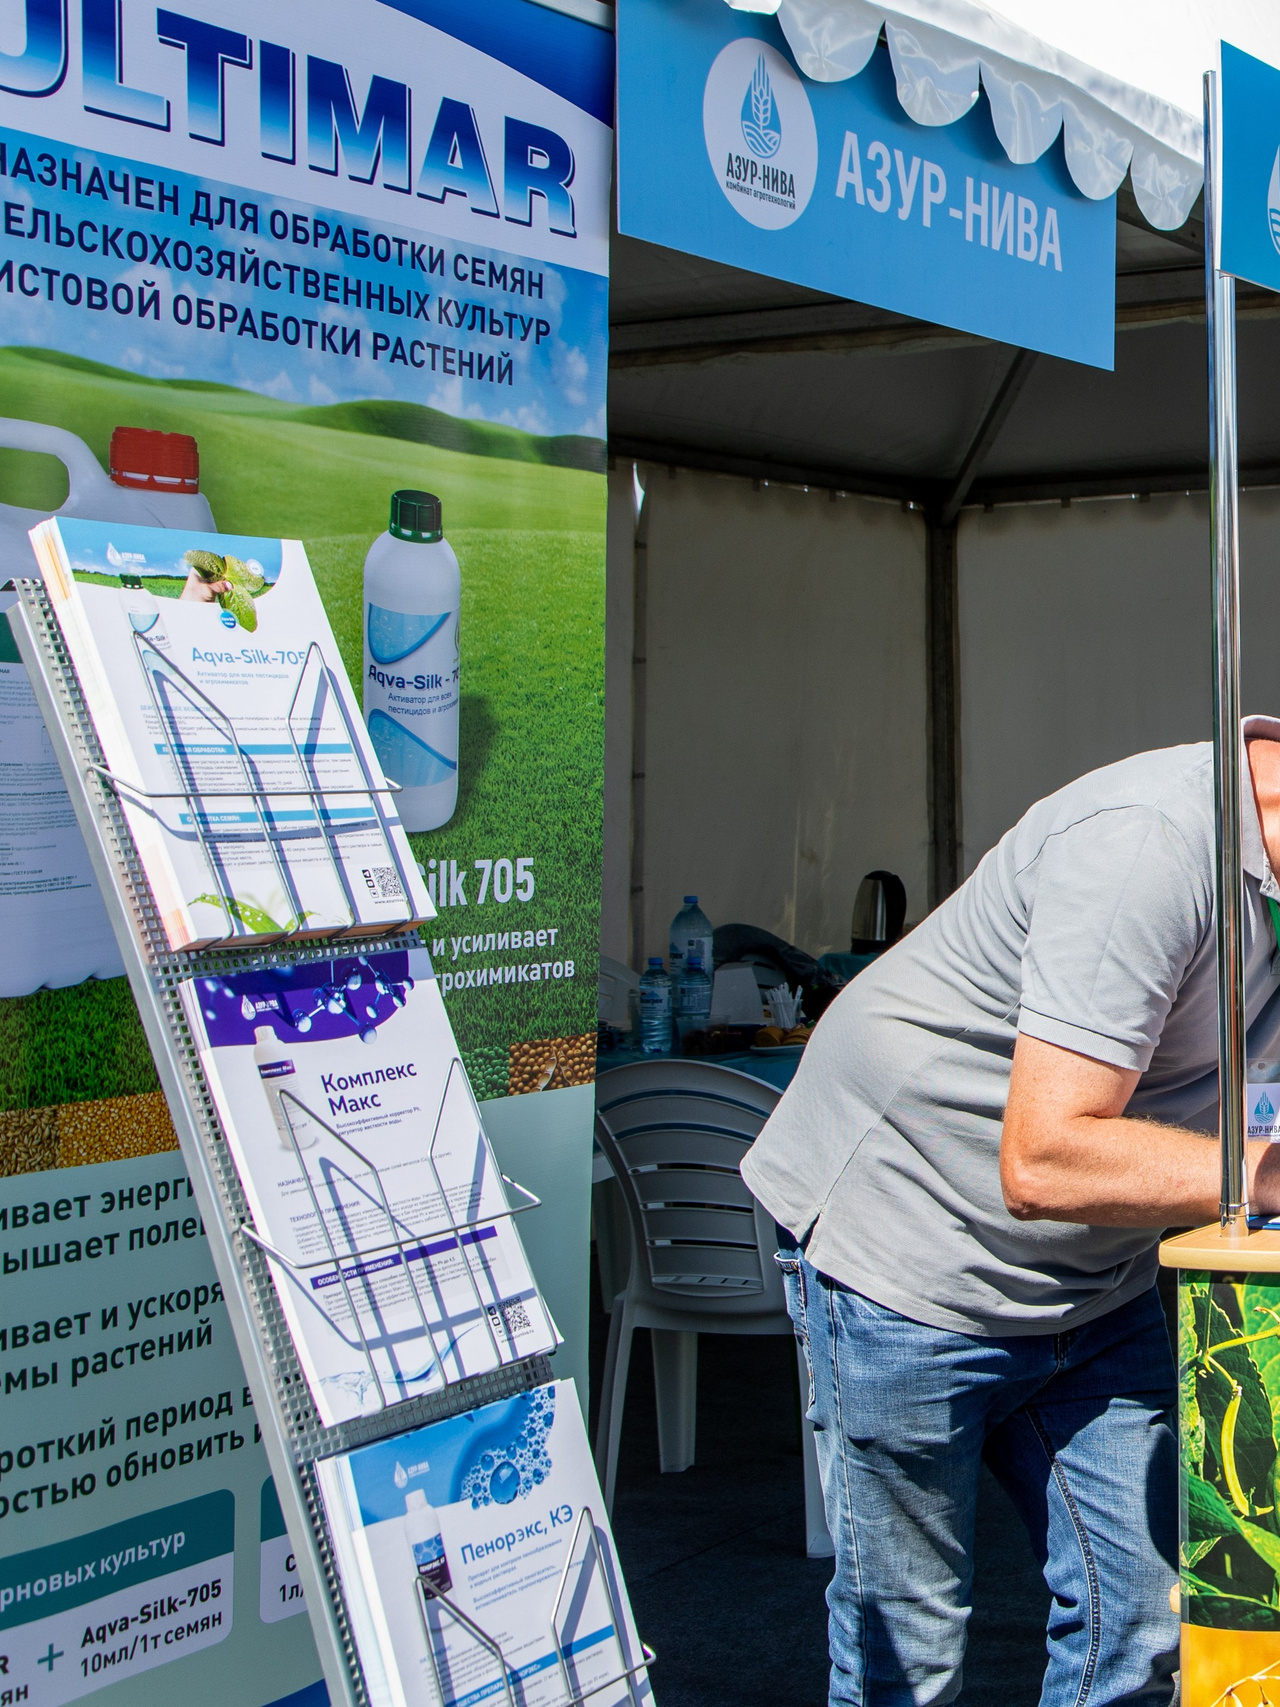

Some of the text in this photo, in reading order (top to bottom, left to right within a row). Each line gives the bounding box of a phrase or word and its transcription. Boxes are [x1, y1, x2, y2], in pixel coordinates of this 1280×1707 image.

[726, 152, 796, 199] АЗУР-НИВА
[726, 180, 796, 211] комбинат агротехнологий
[835, 130, 1063, 272] АЗУР-НИВА
[190, 190, 259, 235] ДЛЯ
[270, 209, 445, 277] ОБРАБОТКИ
[453, 254, 544, 300] СЕМЯН
[4, 203, 551, 345] ЕЛЬСКОХОЗЯЙСТВЕННЫХ КУЛЬТУР
[172, 293, 361, 358] ОБРАБОТКИ
[372, 331, 514, 386] РАСТЕНИЙ
[192, 647, 309, 667] Aqva-Silk-705
[368, 664, 442, 689] Aqva-Silk
[388, 692, 452, 704] Активатор для всех
[388, 705, 430, 716] пестицидов
[474, 857, 535, 905] 705
[432, 928, 559, 961] и усиливает
[321, 1062, 417, 1093] Комплекс
[328, 1093, 381, 1116] Макс
[336, 1113, 388, 1129] Высокоэффективный
[389, 1108, 412, 1119] корректор
[101, 1305, 118, 1330] и
[0, 1317, 213, 1395] мы растений
[126, 1390, 233, 1437] период
[106, 1429, 244, 1488] обновить
[100, 1531, 186, 1576] культур
[460, 1504, 573, 1564] Пенорэкс, КЭ
[80, 1579, 222, 1648] Aqva-Silk-705
[164, 1611, 222, 1645] семян
